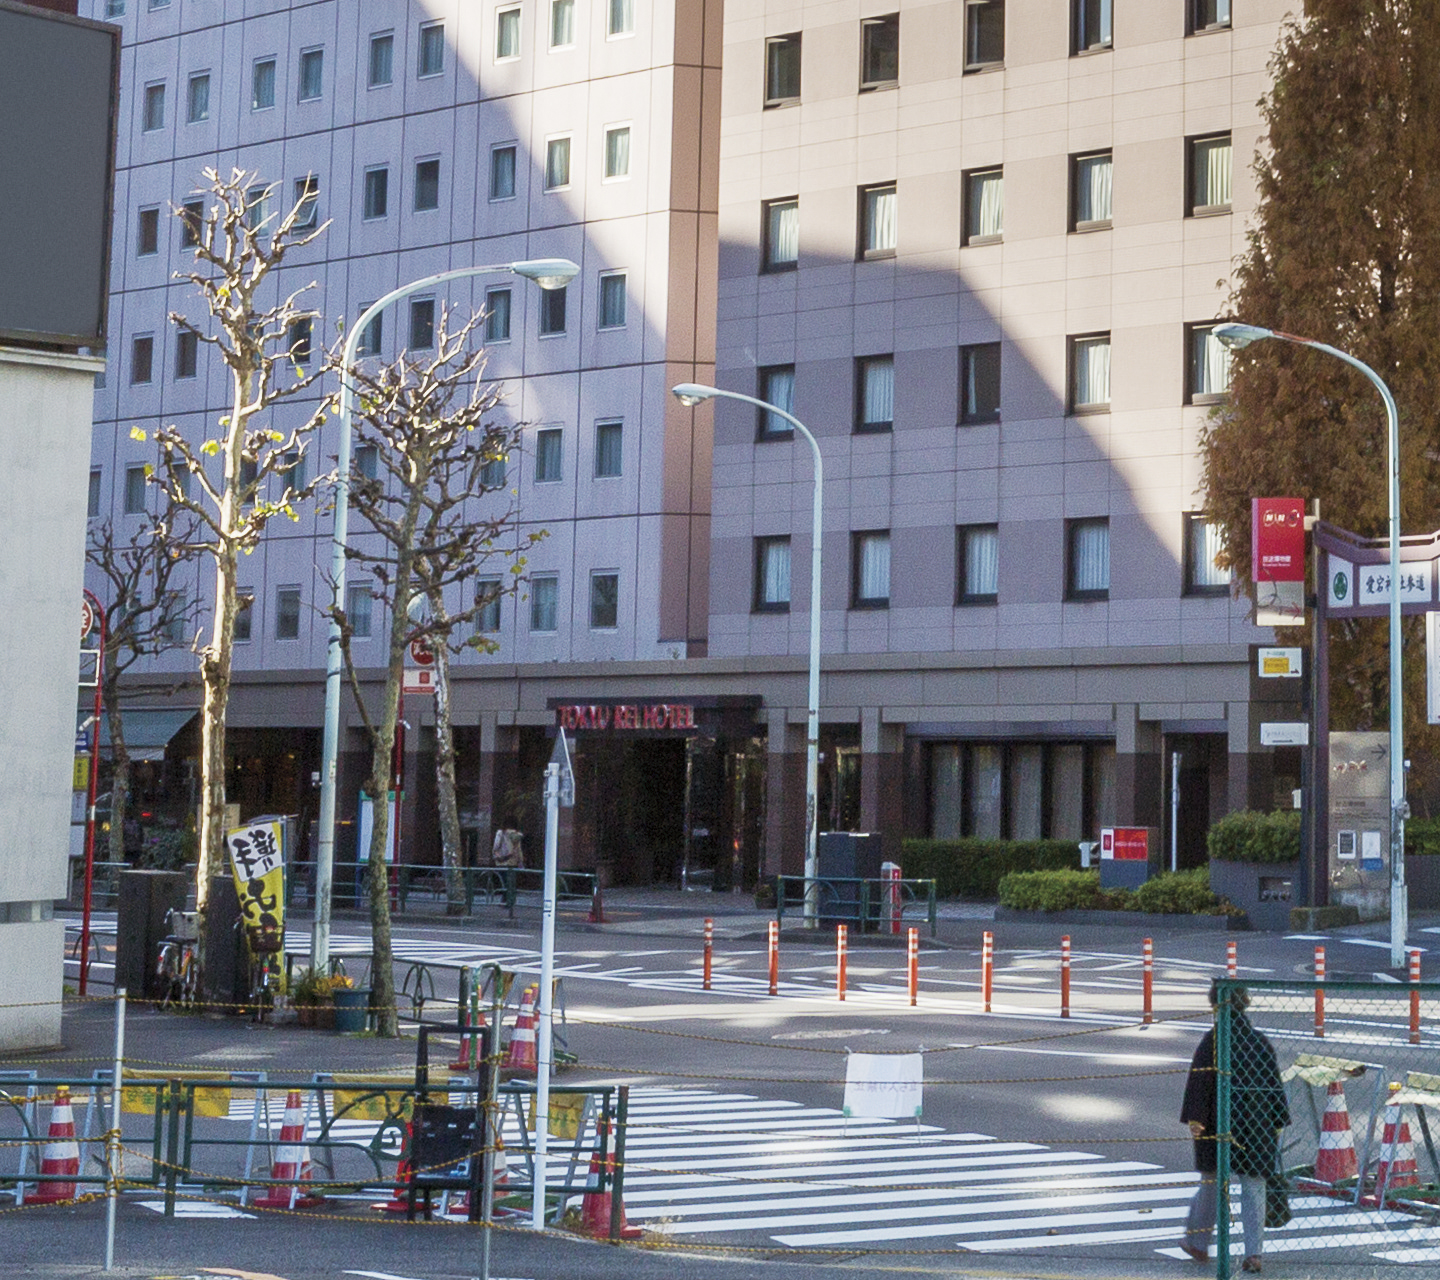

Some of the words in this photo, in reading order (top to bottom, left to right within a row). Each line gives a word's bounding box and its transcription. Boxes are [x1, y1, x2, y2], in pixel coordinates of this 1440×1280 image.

[558, 705, 609, 729] TOKYU
[613, 704, 638, 729] REI
[643, 704, 696, 729] HOTEL
